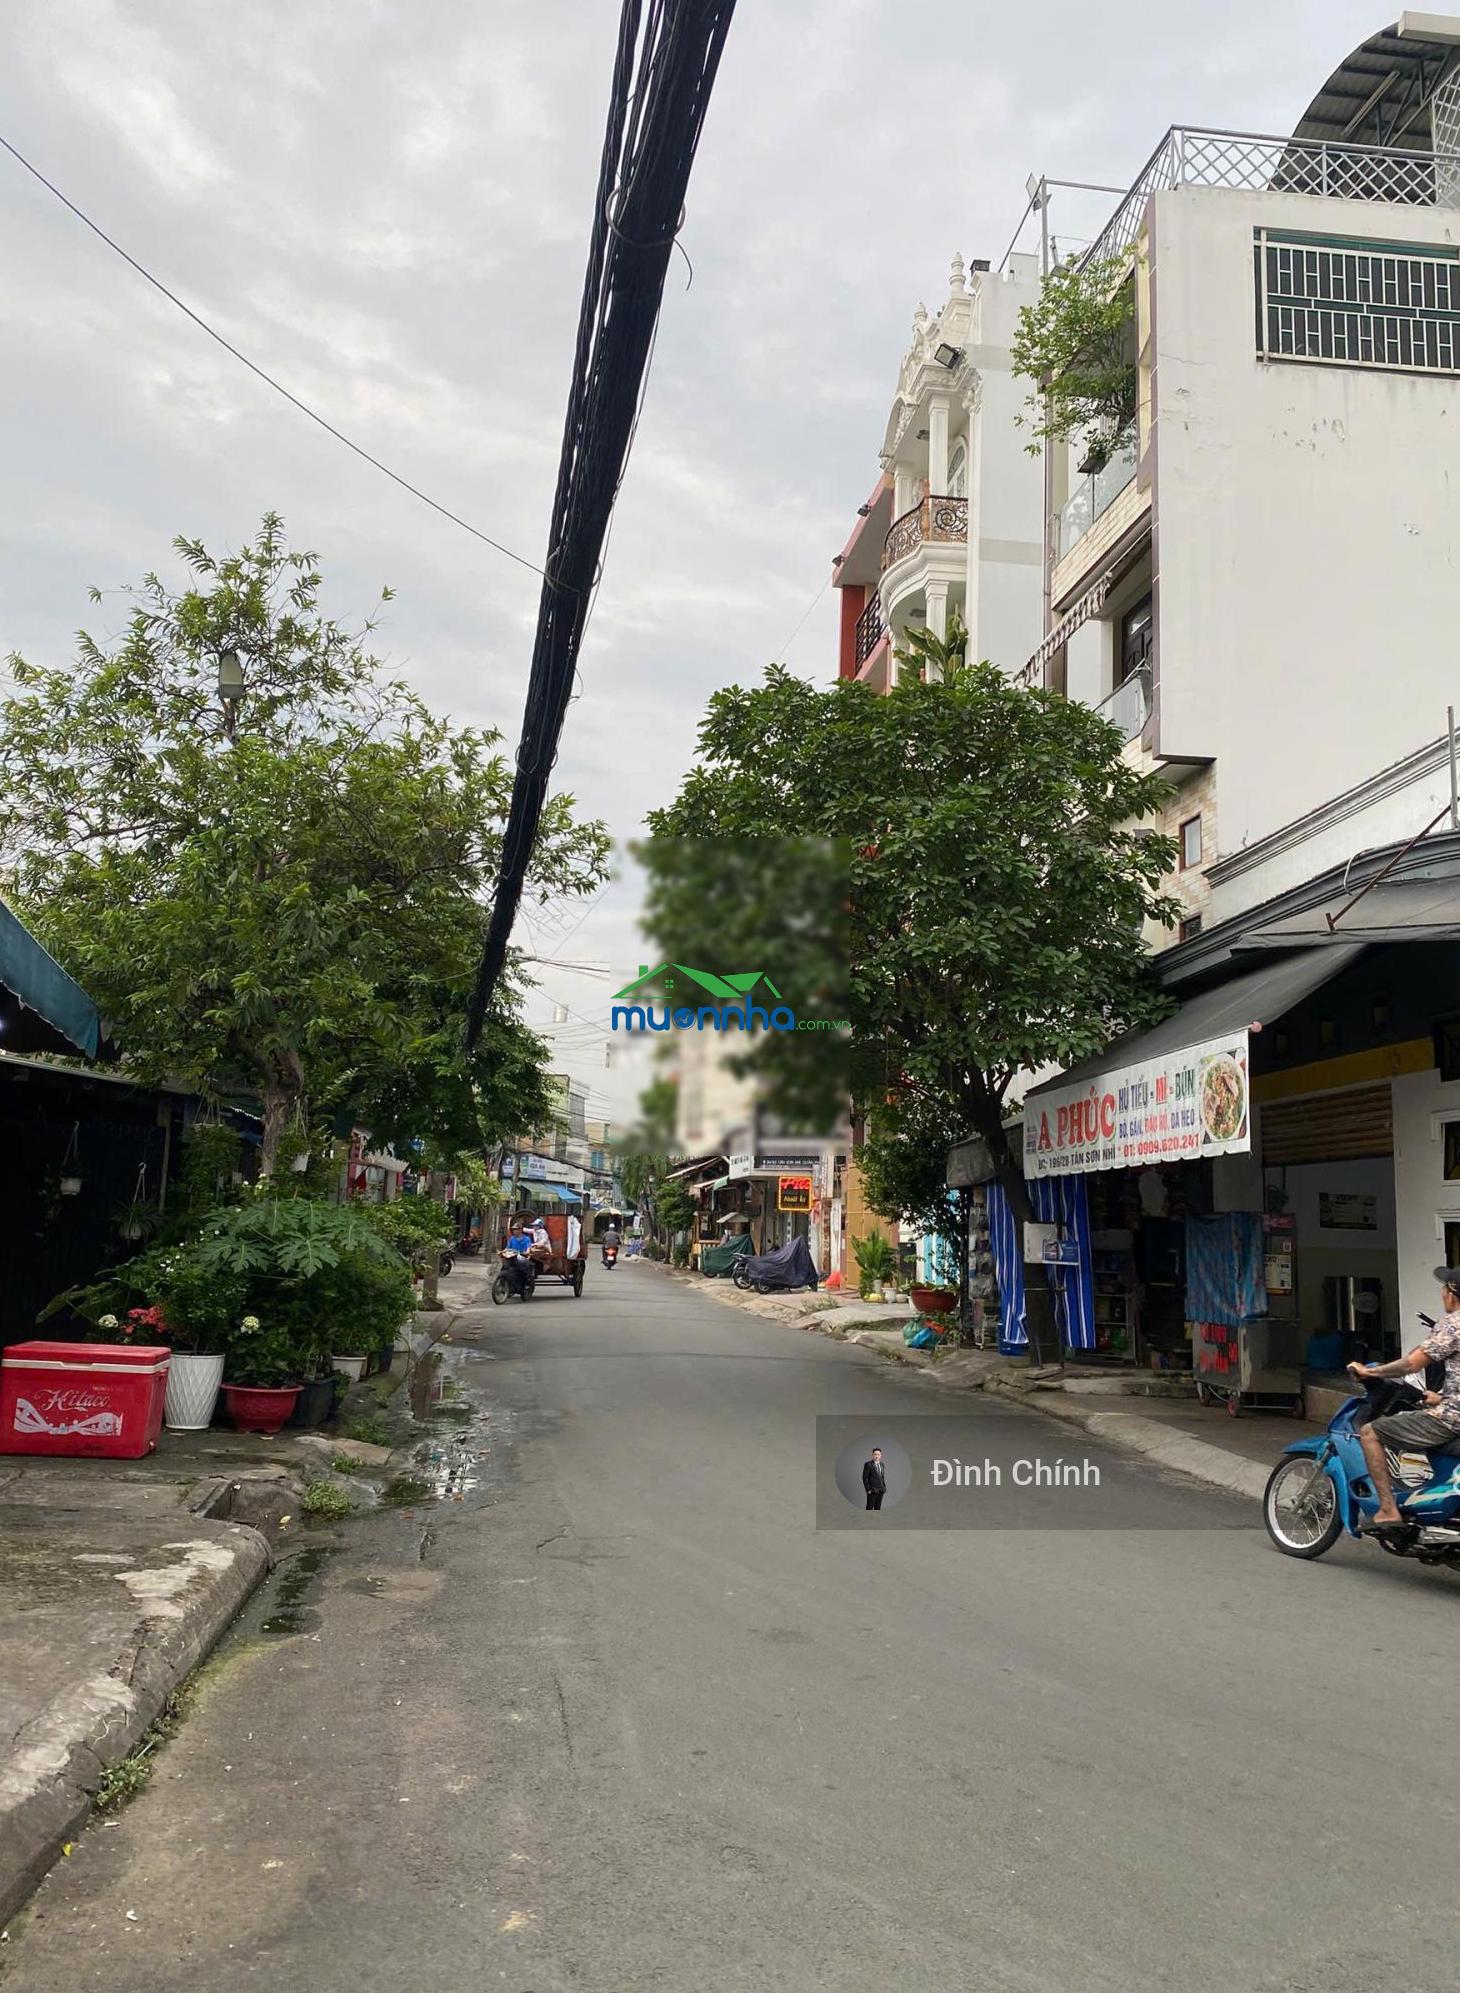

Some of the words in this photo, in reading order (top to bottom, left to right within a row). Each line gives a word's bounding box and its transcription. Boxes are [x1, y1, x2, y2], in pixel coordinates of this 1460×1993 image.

[1176, 1066, 1195, 1100] BÚN
[1037, 1110, 1053, 1151] A
[1056, 1085, 1116, 1149] PHÚC
